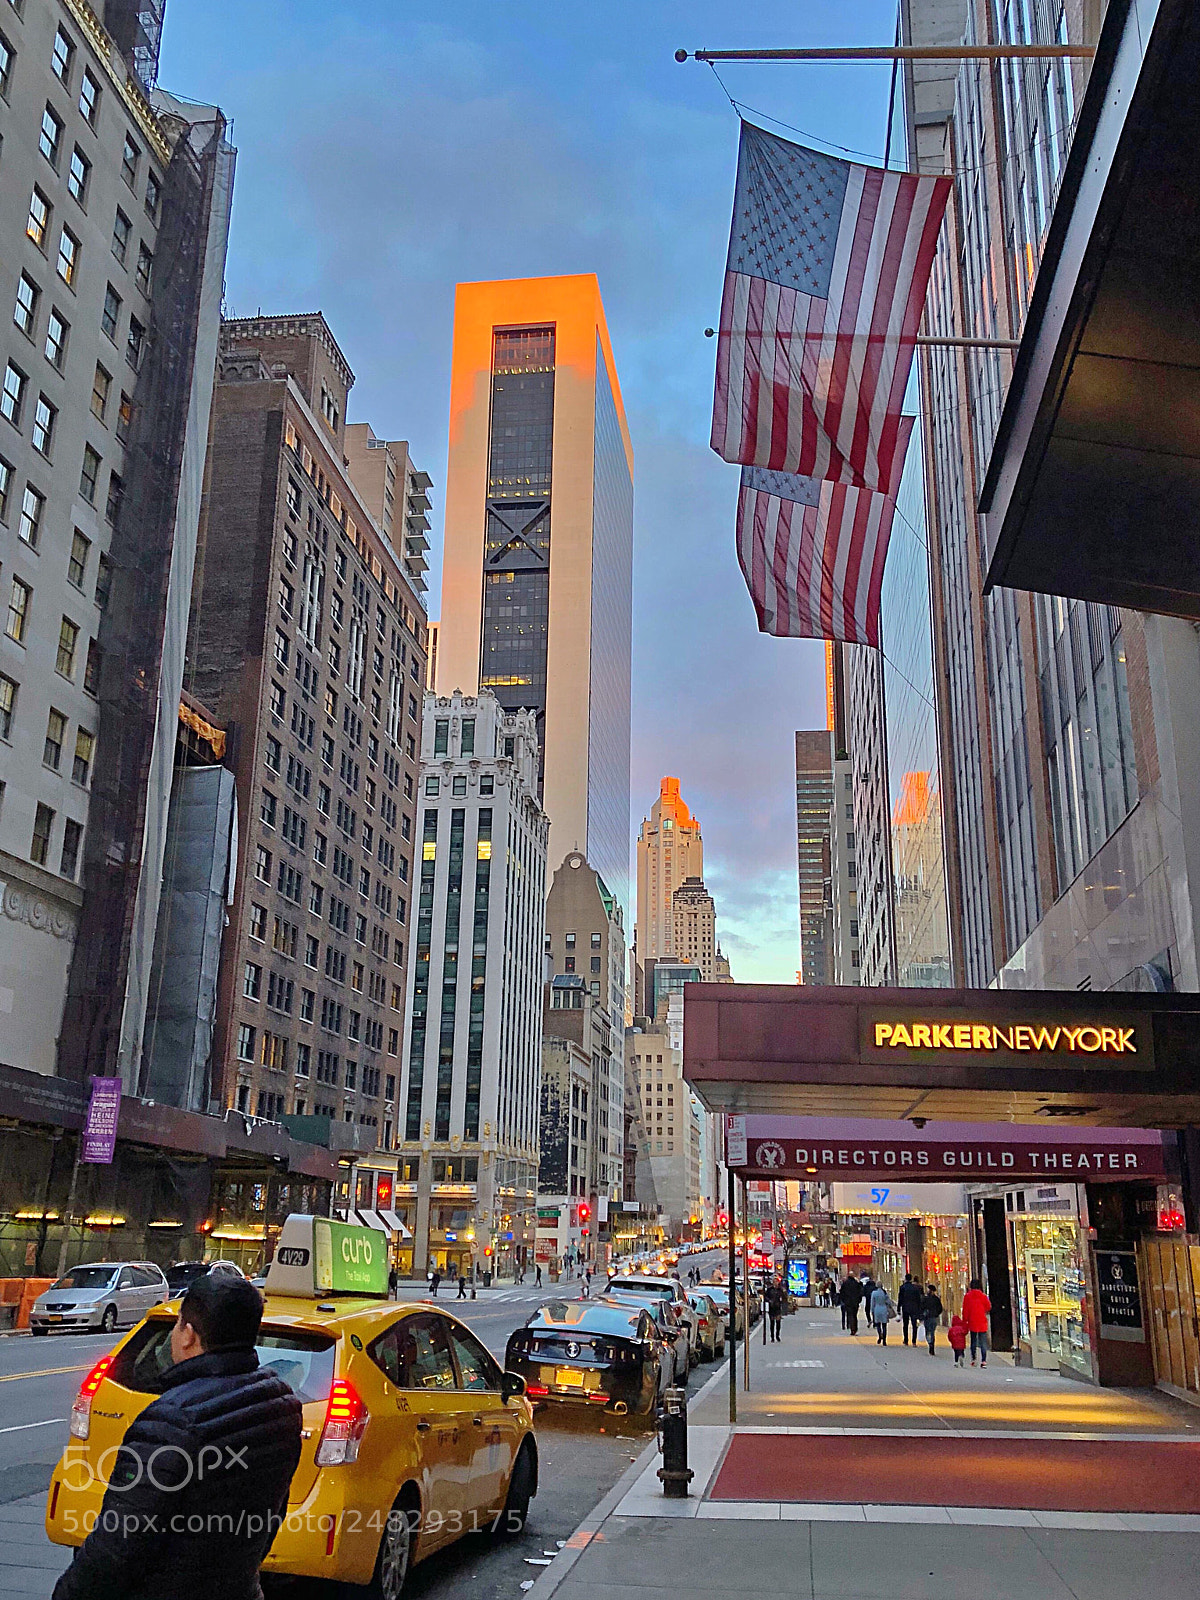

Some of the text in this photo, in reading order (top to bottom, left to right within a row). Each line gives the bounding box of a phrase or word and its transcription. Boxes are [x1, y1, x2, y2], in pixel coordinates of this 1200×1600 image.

[796, 1149, 929, 1165] DIRECTORS
[943, 1151, 1014, 1167] GUILD
[1028, 1153, 1138, 1168] THEATER
[871, 1188, 890, 1206] 57
[281, 1249, 304, 1266] 4V29
[342, 1236, 373, 1265] curb
[1101, 1283, 1136, 1293] DIRECTORS
[1110, 1295, 1130, 1304] GUILD
[1107, 1306, 1135, 1317] THEATER
